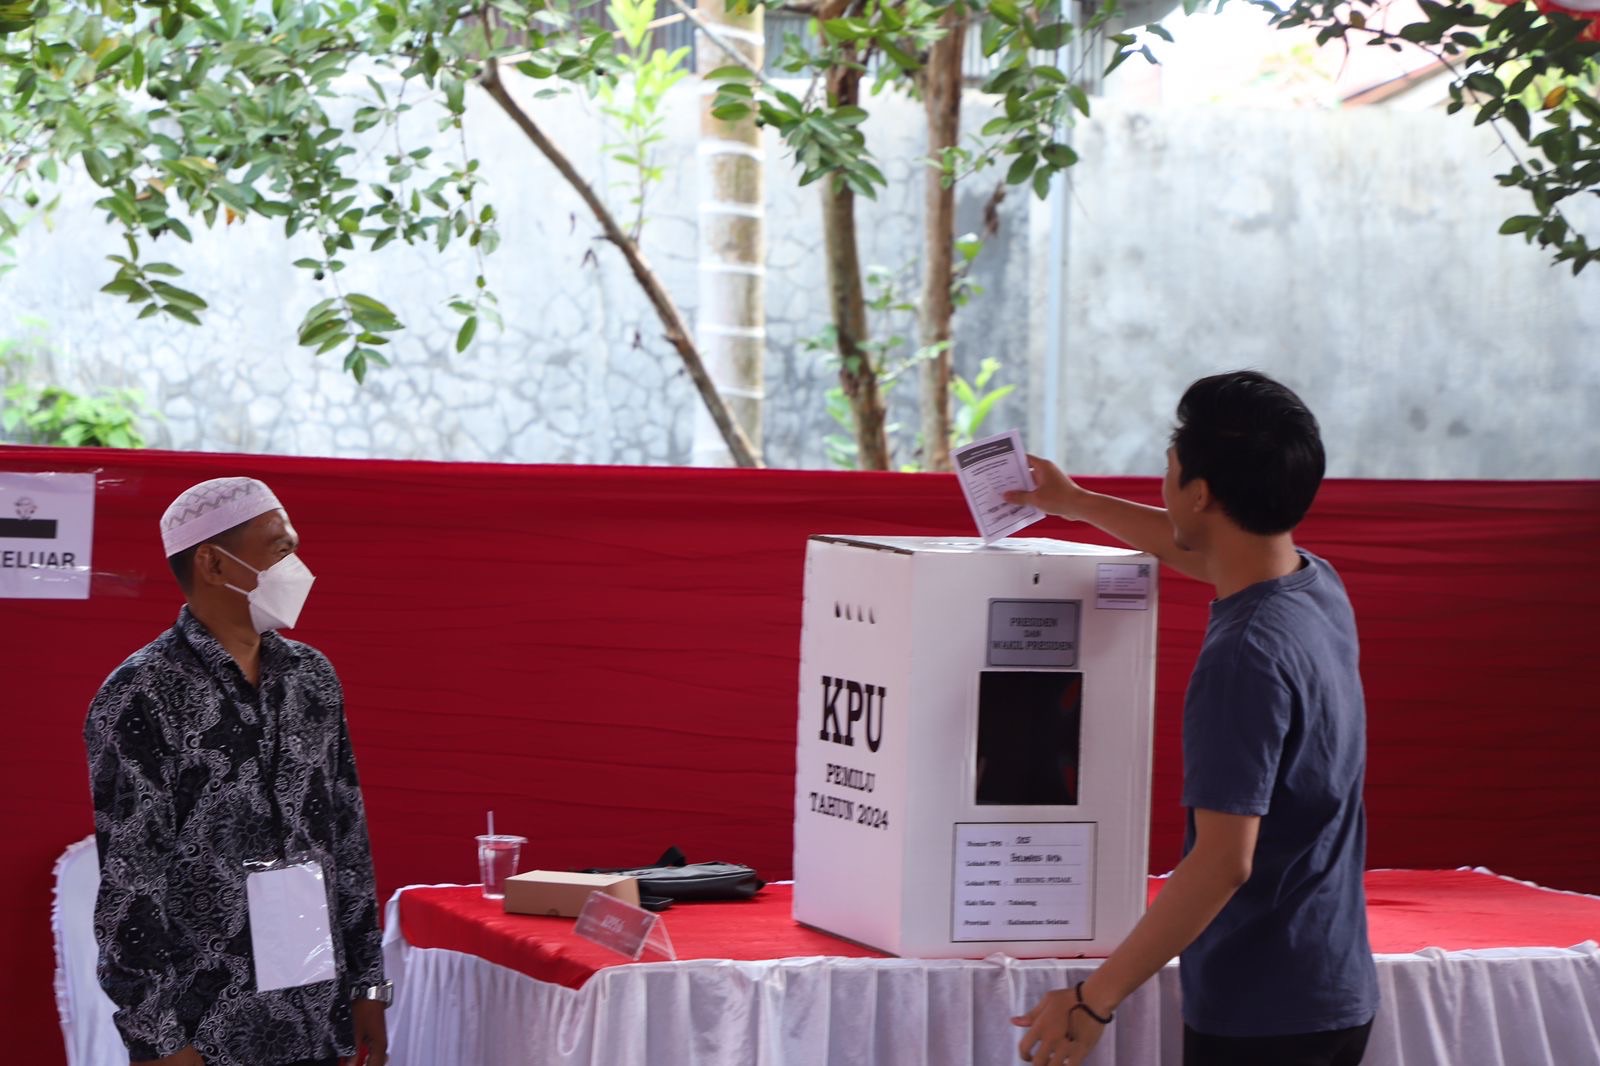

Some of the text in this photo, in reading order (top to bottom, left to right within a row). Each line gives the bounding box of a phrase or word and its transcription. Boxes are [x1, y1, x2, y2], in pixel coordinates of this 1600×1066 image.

[0, 550, 76, 570] ELUAR
[819, 675, 886, 753] KPU
[825, 763, 876, 793] PEMILU
[809, 792, 889, 830] TAHUN 2024
